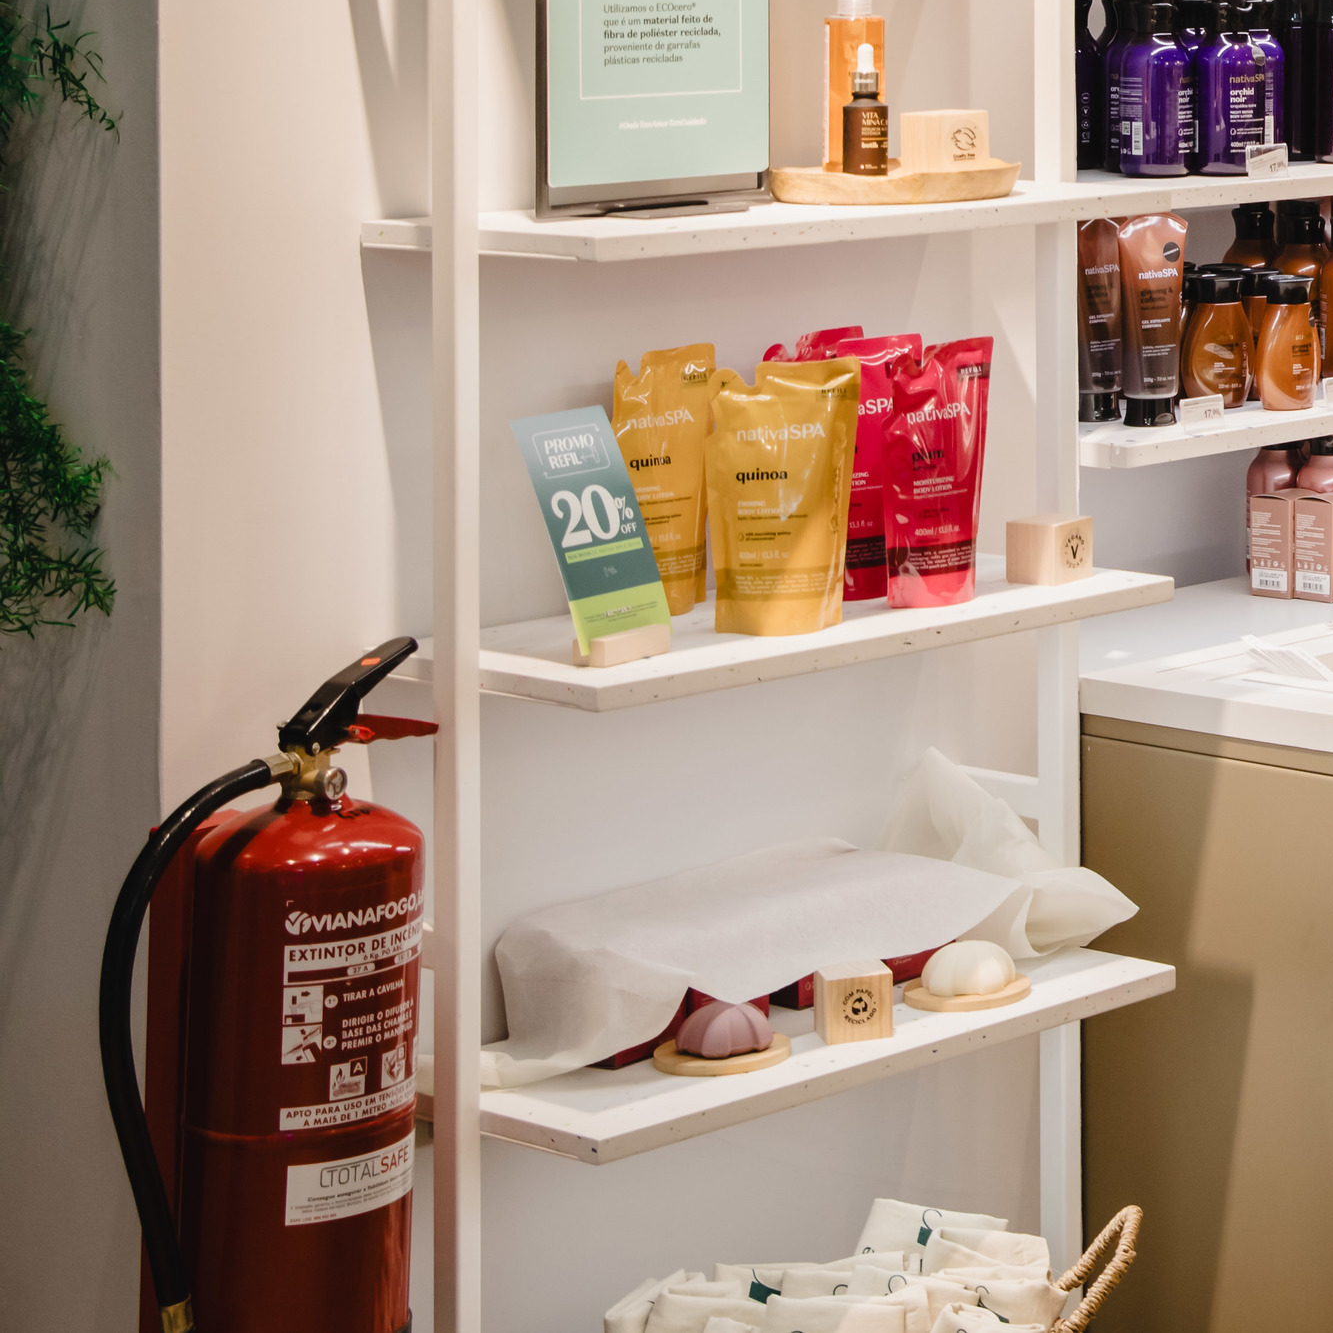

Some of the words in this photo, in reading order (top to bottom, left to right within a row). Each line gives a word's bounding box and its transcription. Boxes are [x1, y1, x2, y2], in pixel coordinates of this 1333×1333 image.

[603, 4, 646, 13] Utilizamos
[604, 19, 619, 27] que
[621, 17, 626, 25] é
[643, 15, 679, 25] material
[681, 15, 700, 24] feito
[703, 15, 713, 23] de
[603, 30, 624, 39] fibra
[627, 30, 637, 38] de
[640, 29, 678, 40] poliéster
[680, 27, 721, 37] reciclada,
[604, 44, 653, 54] proveniente
[655, 42, 665, 50] de
[666, 40, 701, 52] garrafas
[604, 56, 640, 67] plásticas
[642, 54, 683, 63] recicladas
[1230, 87, 1254, 96] orchid
[1139, 268, 1178, 279] nativaSPA
[627, 409, 694, 430] nativaSPA
[907, 402, 971, 425] nativaSPA
[736, 421, 826, 442] nativaSPA
[544, 433, 594, 455] PROMO
[548, 452, 582, 469] REFIL
[630, 454, 671, 469] quinoa
[736, 468, 788, 484] quinoa
[621, 522, 637, 534] OFF
[1065, 534, 1085, 548] VEGANO
[290, 942, 366, 962] EXTINTOR
[371, 937, 386, 951] DE
[343, 992, 366, 1002] TIRAR
[369, 988, 375, 996] A
[377, 979, 404, 994] CAVILHA
[843, 991, 854, 1006] COM
[856, 989, 874, 1000] PAPEL
[342, 1016, 374, 1028] DIRIGIR
[377, 1011, 383, 1019] O
[844, 1008, 877, 1024] RECICLADO
[342, 1029, 363, 1039] BASE
[366, 1025, 382, 1034] DAS
[341, 1038, 372, 1051] PREMIR
[375, 1034, 382, 1043] O
[353, 1062, 364, 1074] A
[286, 1109, 312, 1118] APTO
[315, 1106, 340, 1116] PARA
[344, 1101, 362, 1111] USO
[365, 1098, 377, 1106] EM
[313, 1116, 337, 1126] MAIS
[340, 1113, 351, 1121] DE
[362, 1104, 387, 1117] METRO
[327, 1145, 409, 1187] TOTALSAFE
